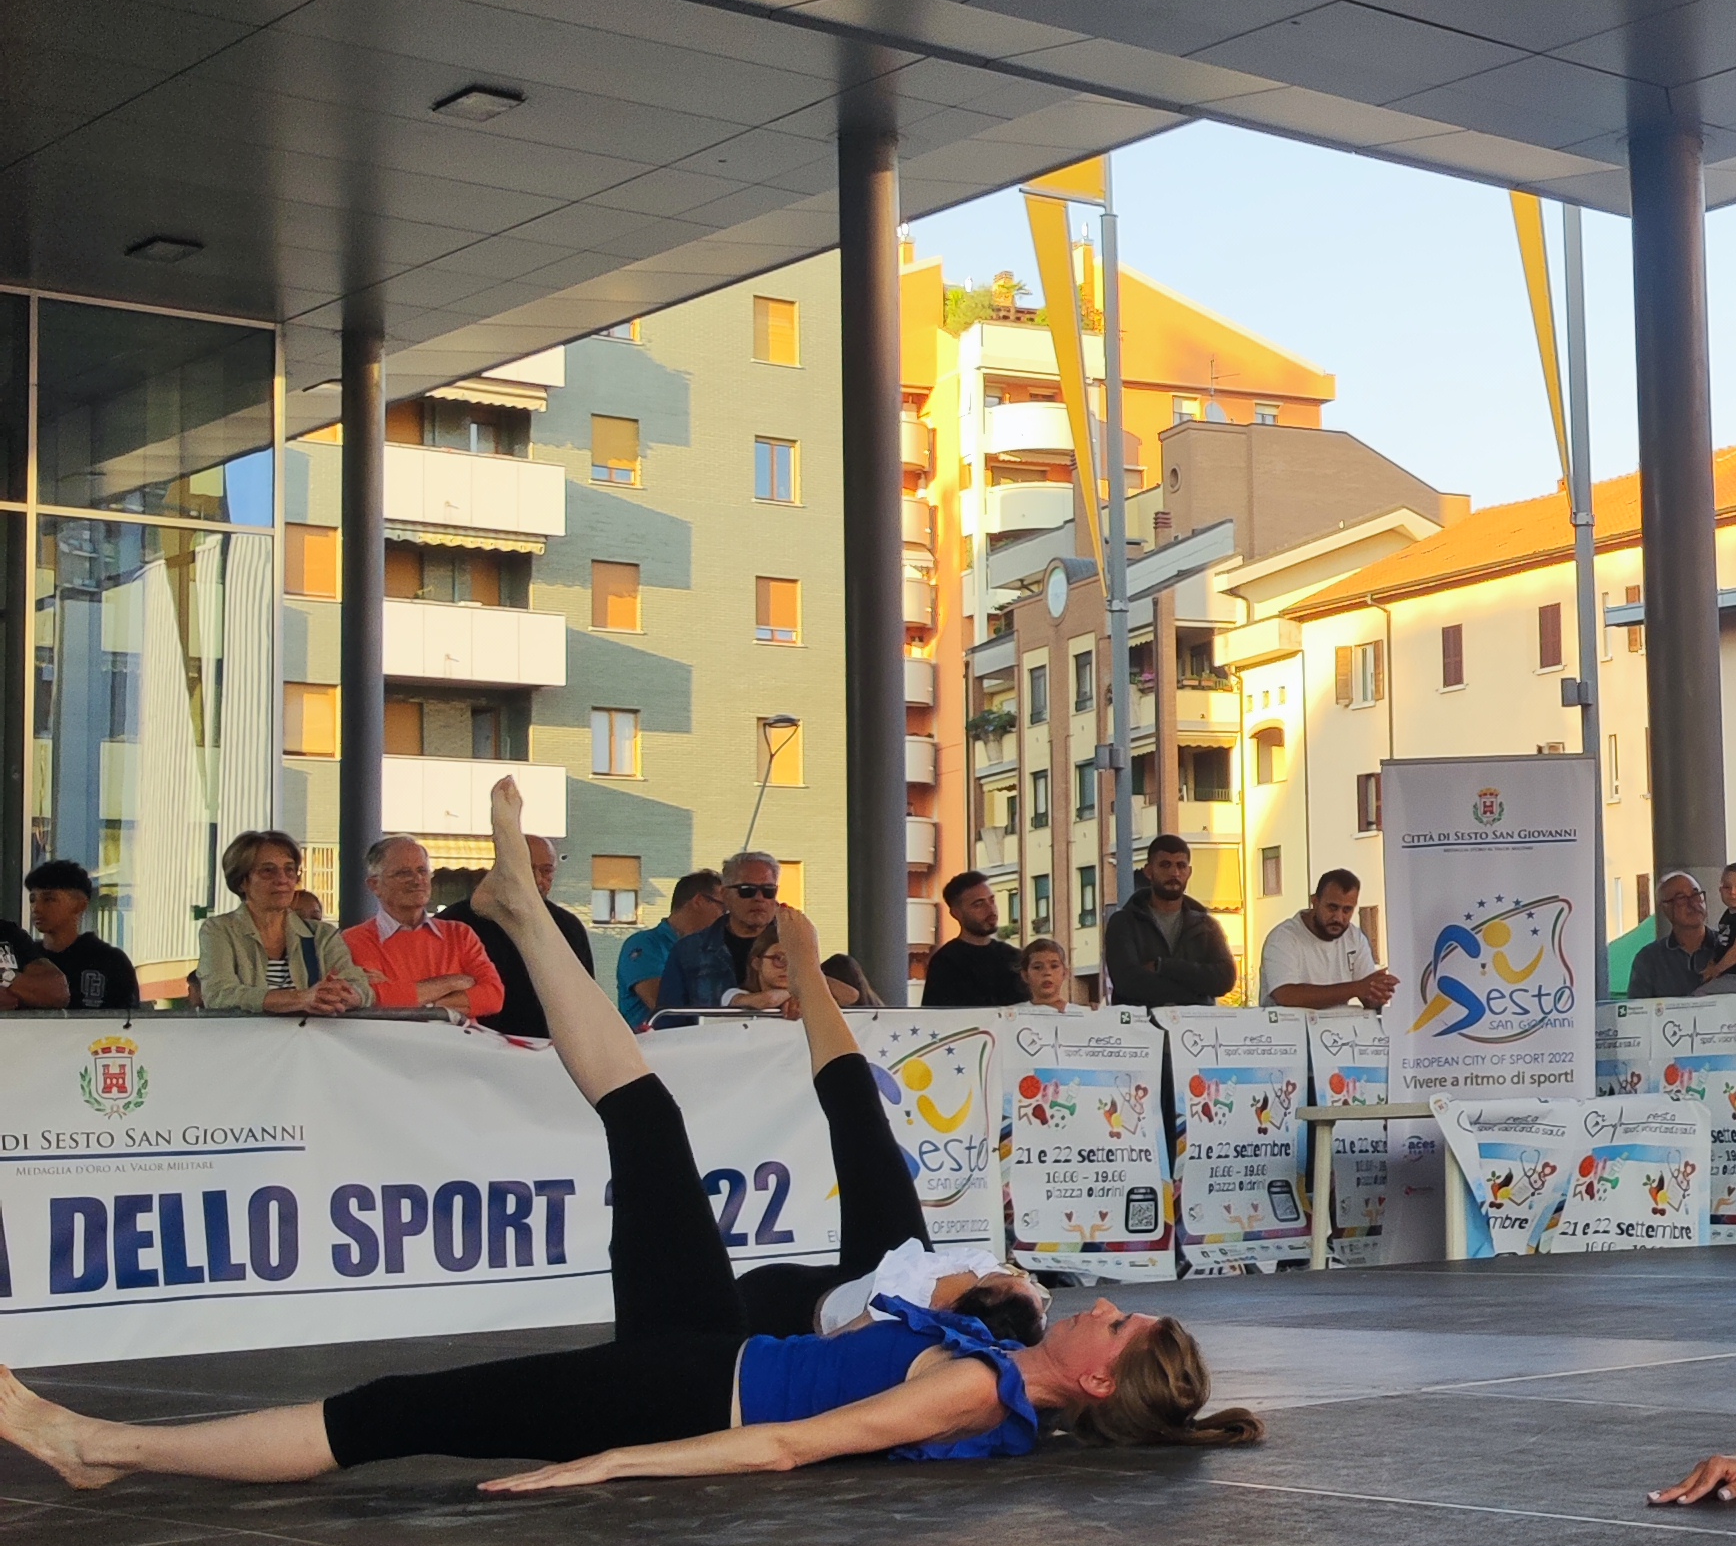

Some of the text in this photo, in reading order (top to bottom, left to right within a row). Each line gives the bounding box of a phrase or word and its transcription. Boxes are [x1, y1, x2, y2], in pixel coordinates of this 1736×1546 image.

[1438, 832, 1450, 841] DI
[1454, 831, 1488, 841] SESTO
[1492, 830, 1514, 840] SAN
[1517, 828, 1577, 839] GIOVANNI
[1402, 1052, 1574, 1069] EUROPEAN CITY OF SPORT 2022
[1403, 1069, 1574, 1089] Vivere a ritmo di sport!
[1, 1133, 28, 1151] DI
[125, 1128, 172, 1147] SAN
[182, 1125, 304, 1145] GIOVANNI
[1015, 1145, 1152, 1164] 21 e 22 settembre
[1189, 1141, 1291, 1160] 21 e 22 settembre
[50, 1185, 299, 1295] DELLO
[330, 1178, 576, 1277] SPORT
[605, 1161, 795, 1247] 22
[1559, 1218, 1692, 1240] 21 e 22 settembre
